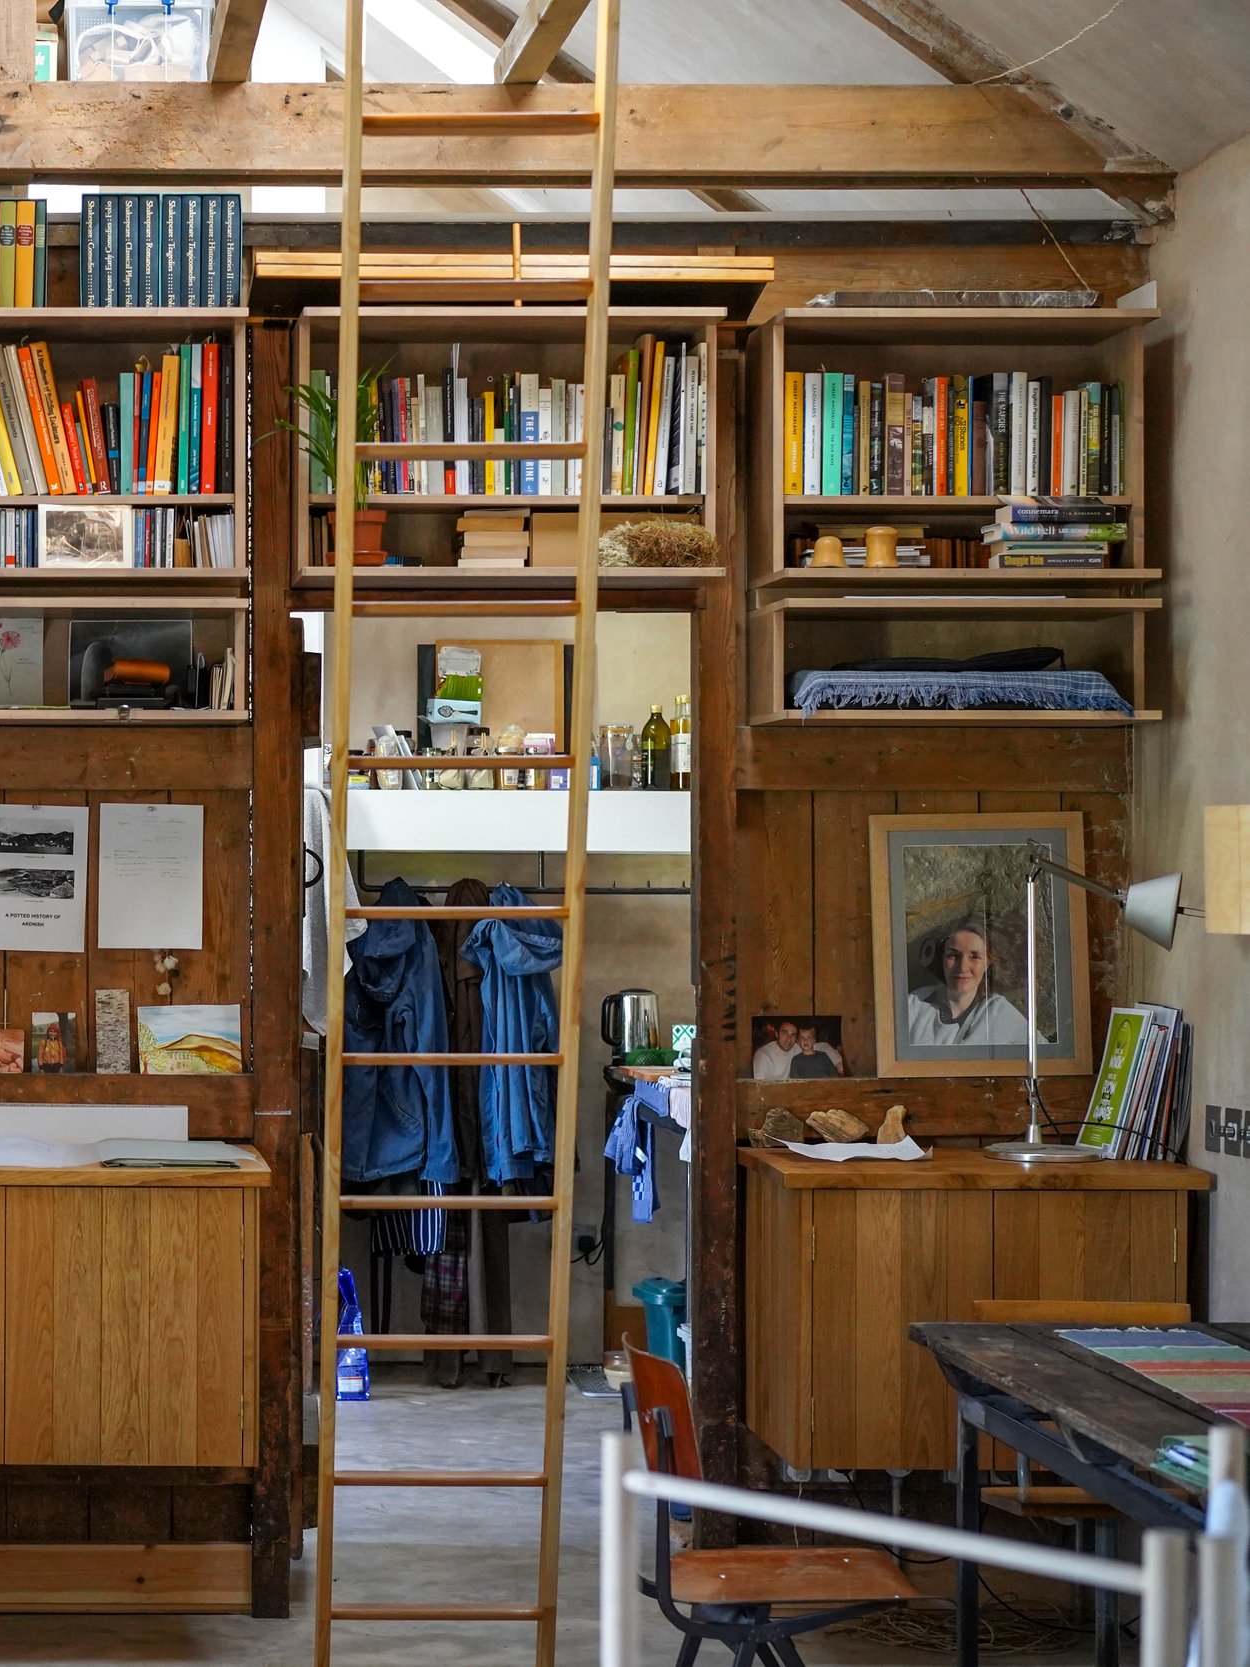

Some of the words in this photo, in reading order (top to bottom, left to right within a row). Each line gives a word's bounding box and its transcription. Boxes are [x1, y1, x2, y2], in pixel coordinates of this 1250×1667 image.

[86, 200, 95, 239] Shakespeare
[124, 200, 133, 239] Shakespeare
[144, 200, 154, 239] Shakespeare
[166, 200, 176, 239] Shakespeare
[187, 200, 196, 239] Shakespeare
[207, 200, 216, 239] Shakespeare
[225, 200, 235, 239] Shakespeare
[87, 242, 95, 274] Comedies
[125, 242, 133, 269] Classical
[145, 242, 153, 275] Romances
[166, 242, 176, 272] Tragedies
[186, 242, 196, 287] Tragicomedies
[208, 242, 216, 271] Histories
[105, 275, 114, 307] hakespeare
[124, 270, 133, 286] Plays
[0, 380, 11, 401] Wood
[37, 357, 50, 386] Handbook
[49, 415, 62, 445] Enclosure
[997, 392, 1006, 403] THE
[1031, 387, 1039, 408] English
[5, 402, 15, 421] Wood
[88, 388, 101, 428] CONSTRUCTION
[525, 415, 535, 432] THE
[997, 403, 1006, 433] MARCHES
[1031, 408, 1039, 430] Pastoral
[9, 419, 20, 439] Joints
[914, 405, 922, 446] NATIVE
[93, 429, 105, 460] CONTRACTS
[525, 435, 535, 482] PRINE
[1009, 525, 1036, 535] Wild
